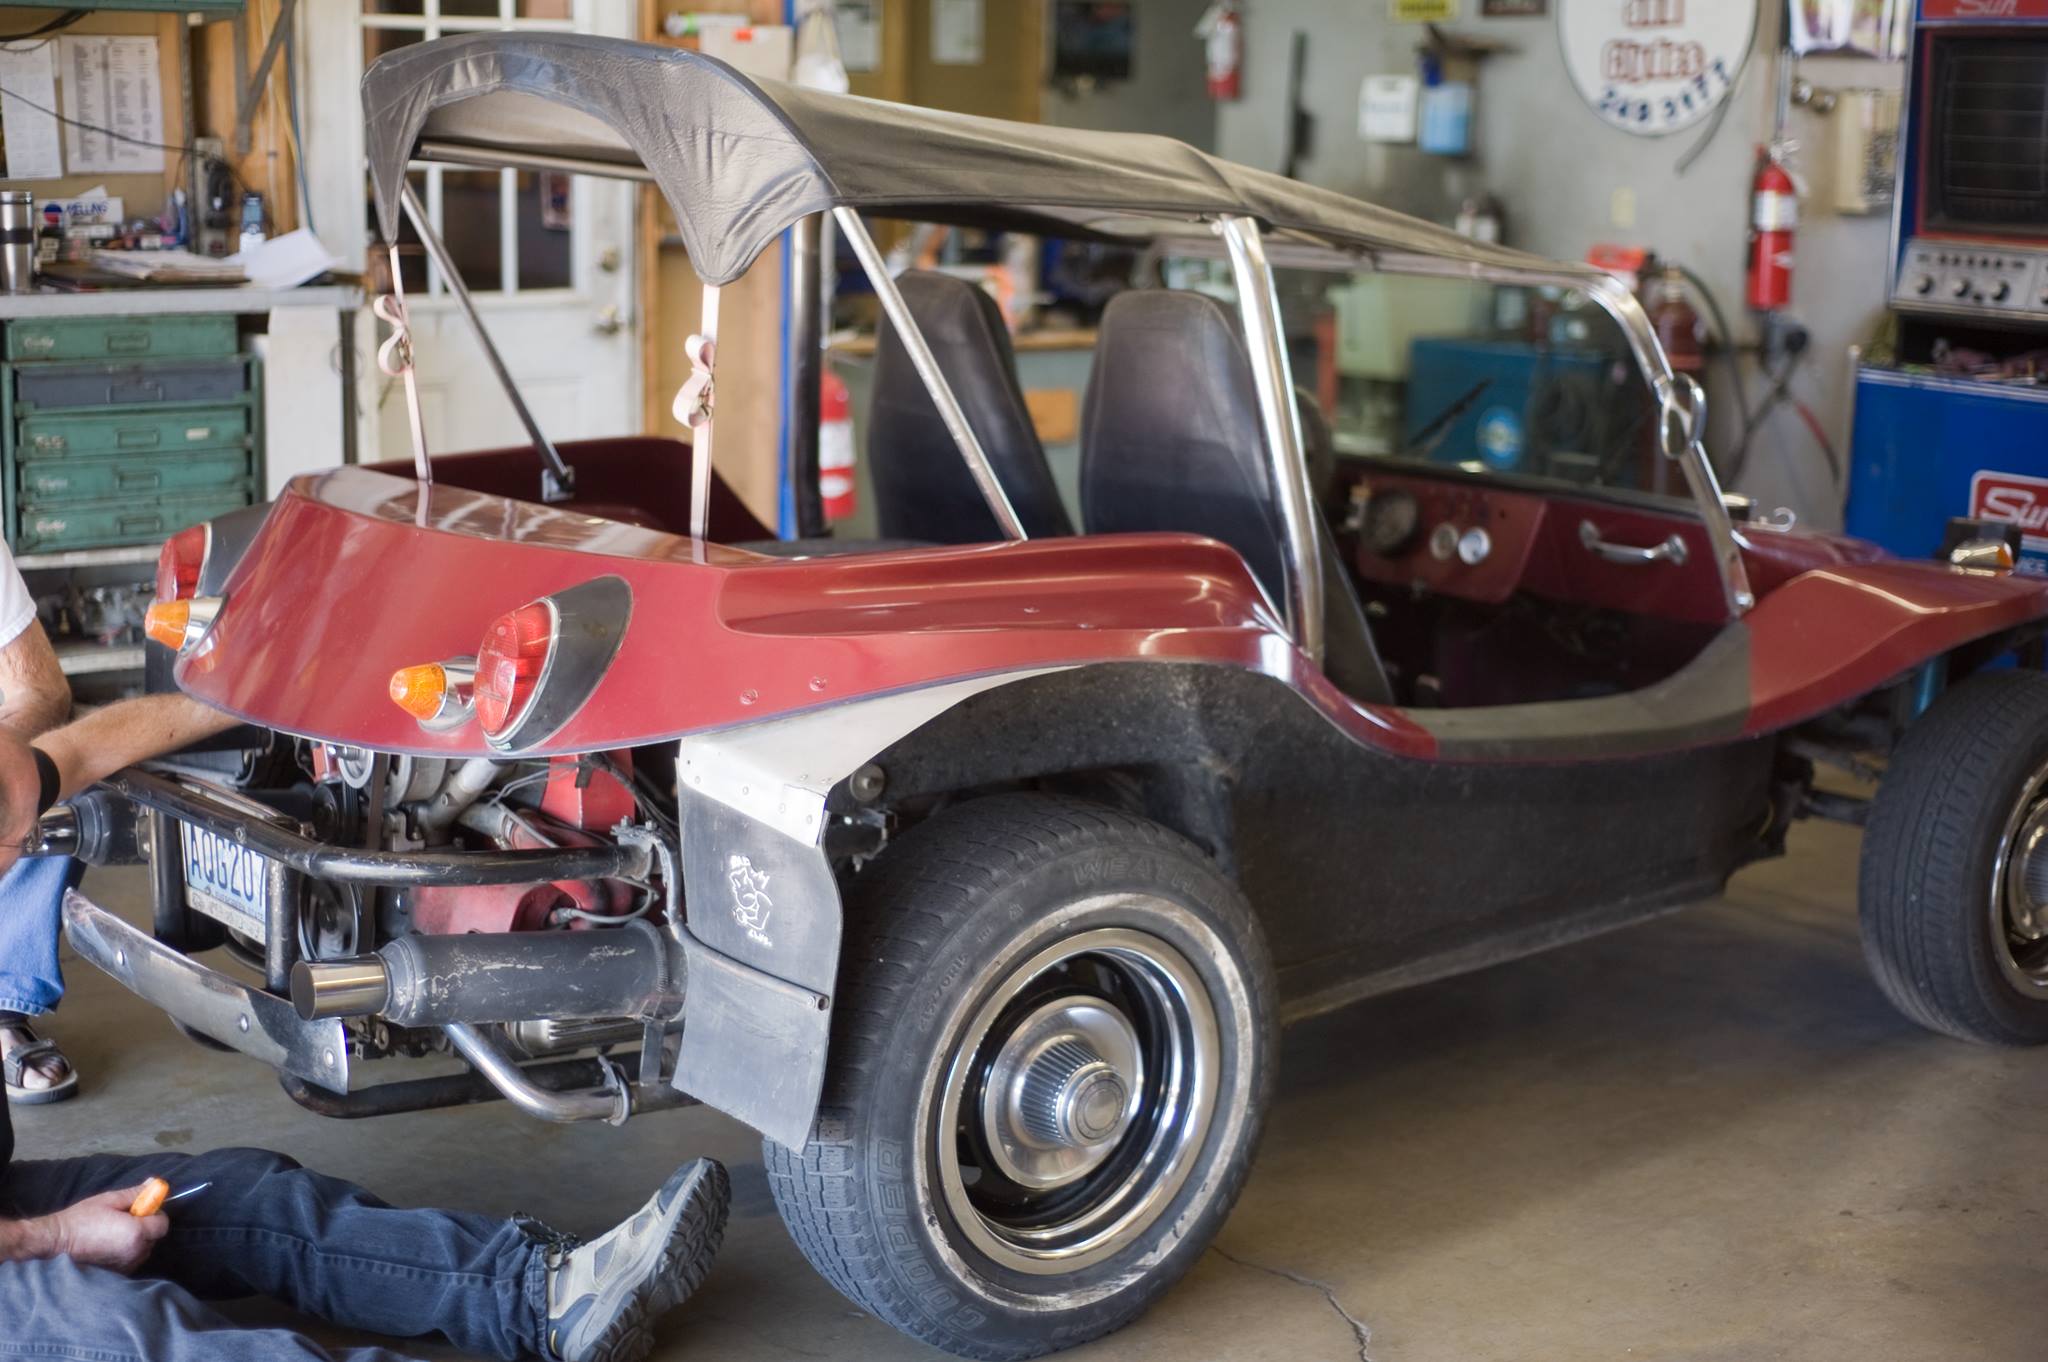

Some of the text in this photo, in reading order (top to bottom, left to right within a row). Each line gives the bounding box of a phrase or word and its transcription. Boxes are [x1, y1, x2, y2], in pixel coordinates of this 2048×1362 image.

[1980, 486, 2048, 530] Su
[191, 822, 266, 908] AQG207
[877, 1138, 987, 1331] COOPER
